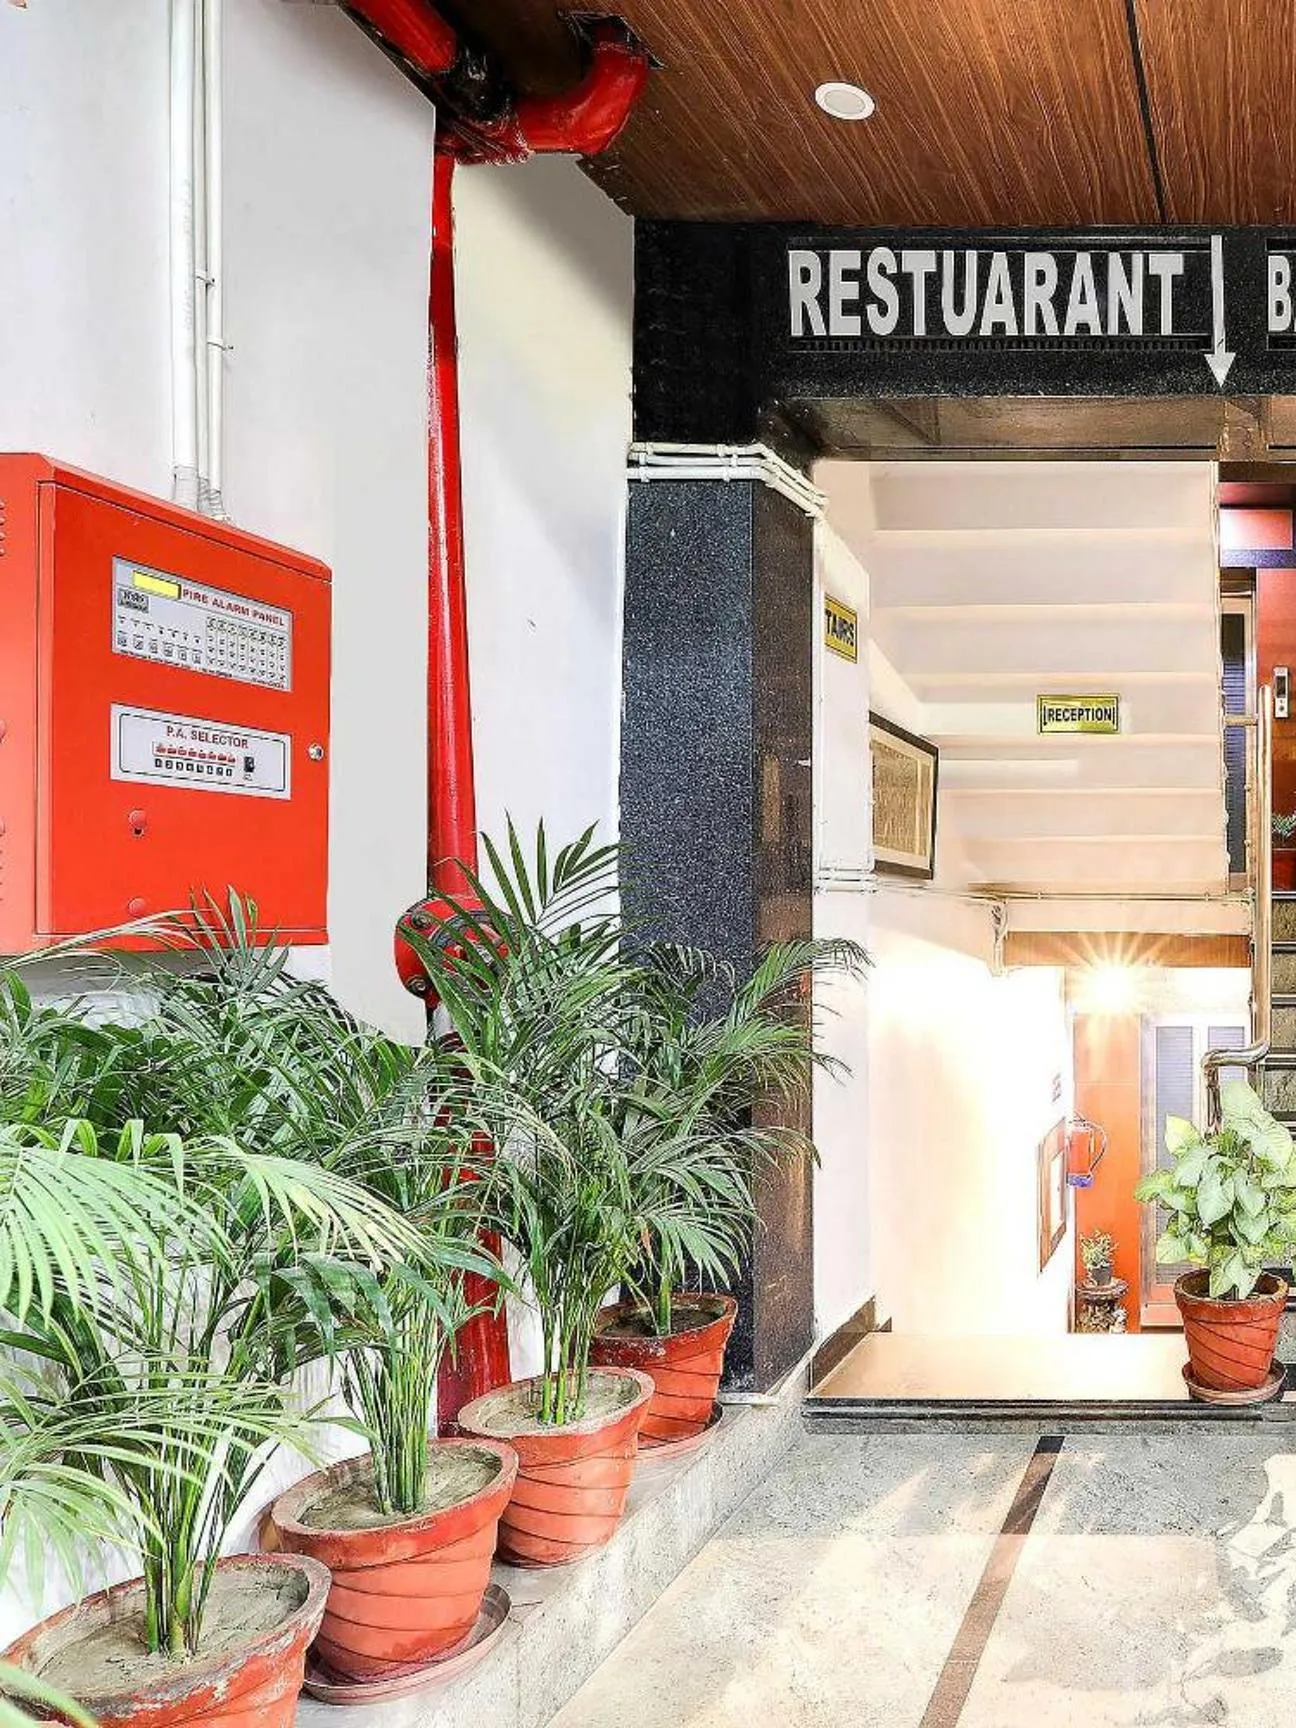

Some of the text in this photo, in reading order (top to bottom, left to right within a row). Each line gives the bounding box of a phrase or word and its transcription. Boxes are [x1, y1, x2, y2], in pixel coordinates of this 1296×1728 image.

[788, 246, 1185, 336] RESTUARANT
[212, 597, 251, 617] ALARM
[252, 609, 286, 627] PANEL
[1047, 707, 1112, 722] RECEPTION
[166, 725, 250, 749] P.A. SELECTOR
